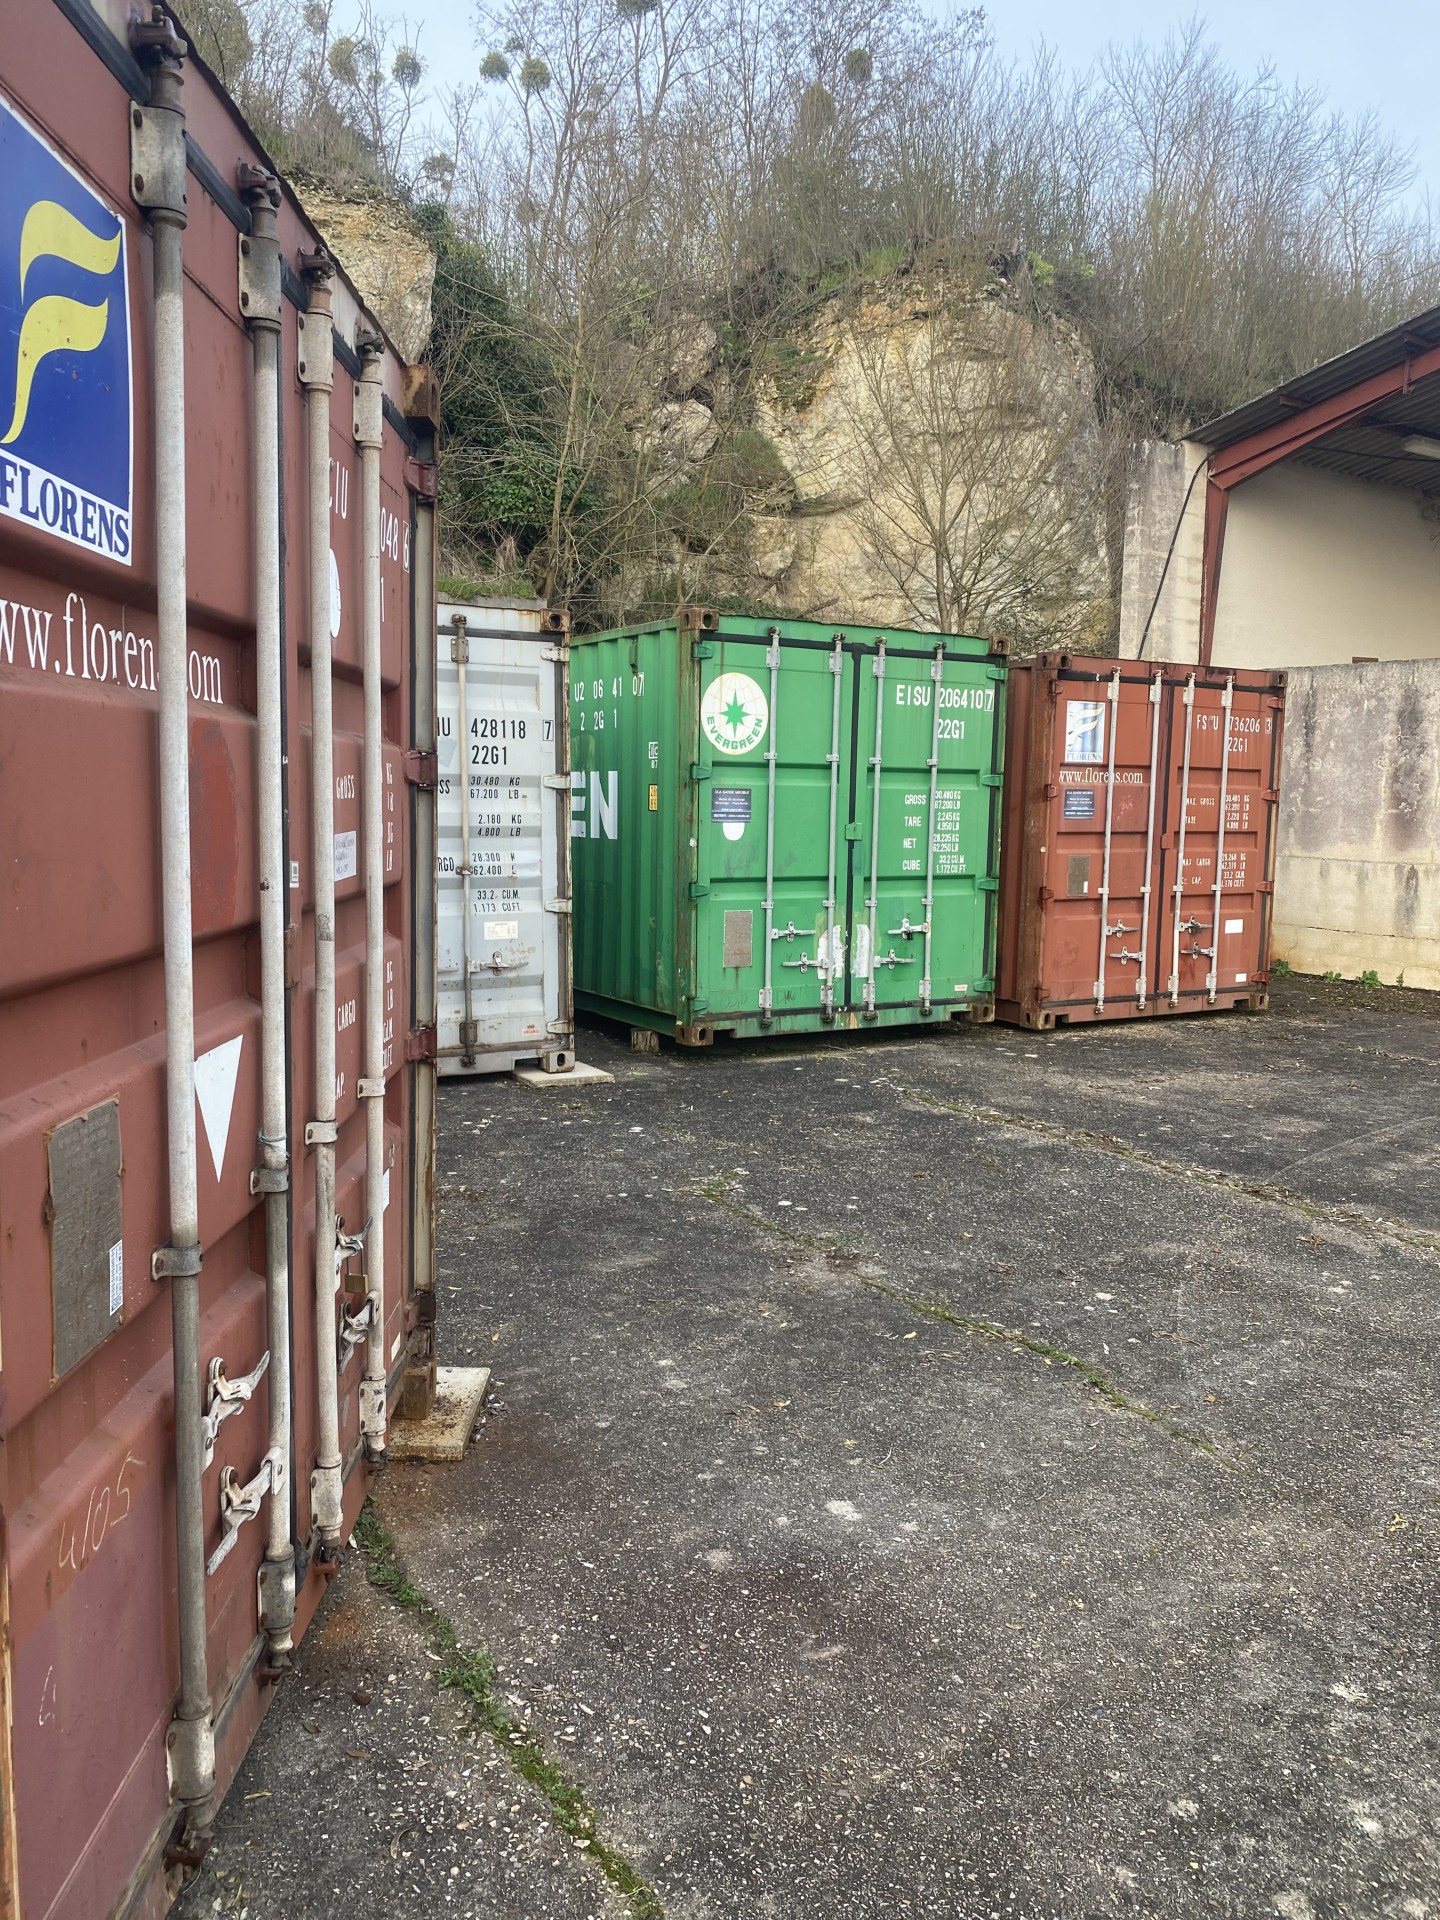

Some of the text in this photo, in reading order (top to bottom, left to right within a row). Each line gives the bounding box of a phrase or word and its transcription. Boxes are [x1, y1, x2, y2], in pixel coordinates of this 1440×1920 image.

[0, 457, 129, 558] FLORENS
[896, 684, 931, 706] EISU
[470, 718, 526, 739] 428118
[543, 720, 553, 741] 7
[938, 718, 965, 739] 22G1
[1229, 716, 1261, 733] 736206
[706, 715, 763, 750] EVERGREEN
[1228, 736, 1248, 752] 22G1
[471, 744, 507, 765] 22G1
[1066, 752, 1102, 761] FLORENS
[470, 775, 521, 786] 30.480 KG
[1058, 767, 1144, 784] www.flores.com
[336, 774, 355, 799] GROSS
[470, 788, 519, 799] 67.200 LB
[904, 794, 927, 805] GROSS
[954, 790, 961, 800] KG
[954, 801, 961, 810] LB
[478, 814, 522, 825] 2.180 KG
[904, 816, 922, 827] TARE
[953, 812, 960, 821] KG
[953, 822, 960, 831] LB
[477, 827, 521, 837] 4.800 LB
[903, 837, 917, 849] NET
[952, 833, 959, 842] KG
[952, 843, 959, 852] LB
[472, 852, 501, 863] 28.300
[902, 859, 921, 870] CUBE
[473, 865, 502, 876] 62.400
[477, 889, 495, 900] 33.2
[473, 903, 497, 913] 1.173
[337, 999, 356, 1032] CARGO
[335, 1071, 346, 1101] AP.
